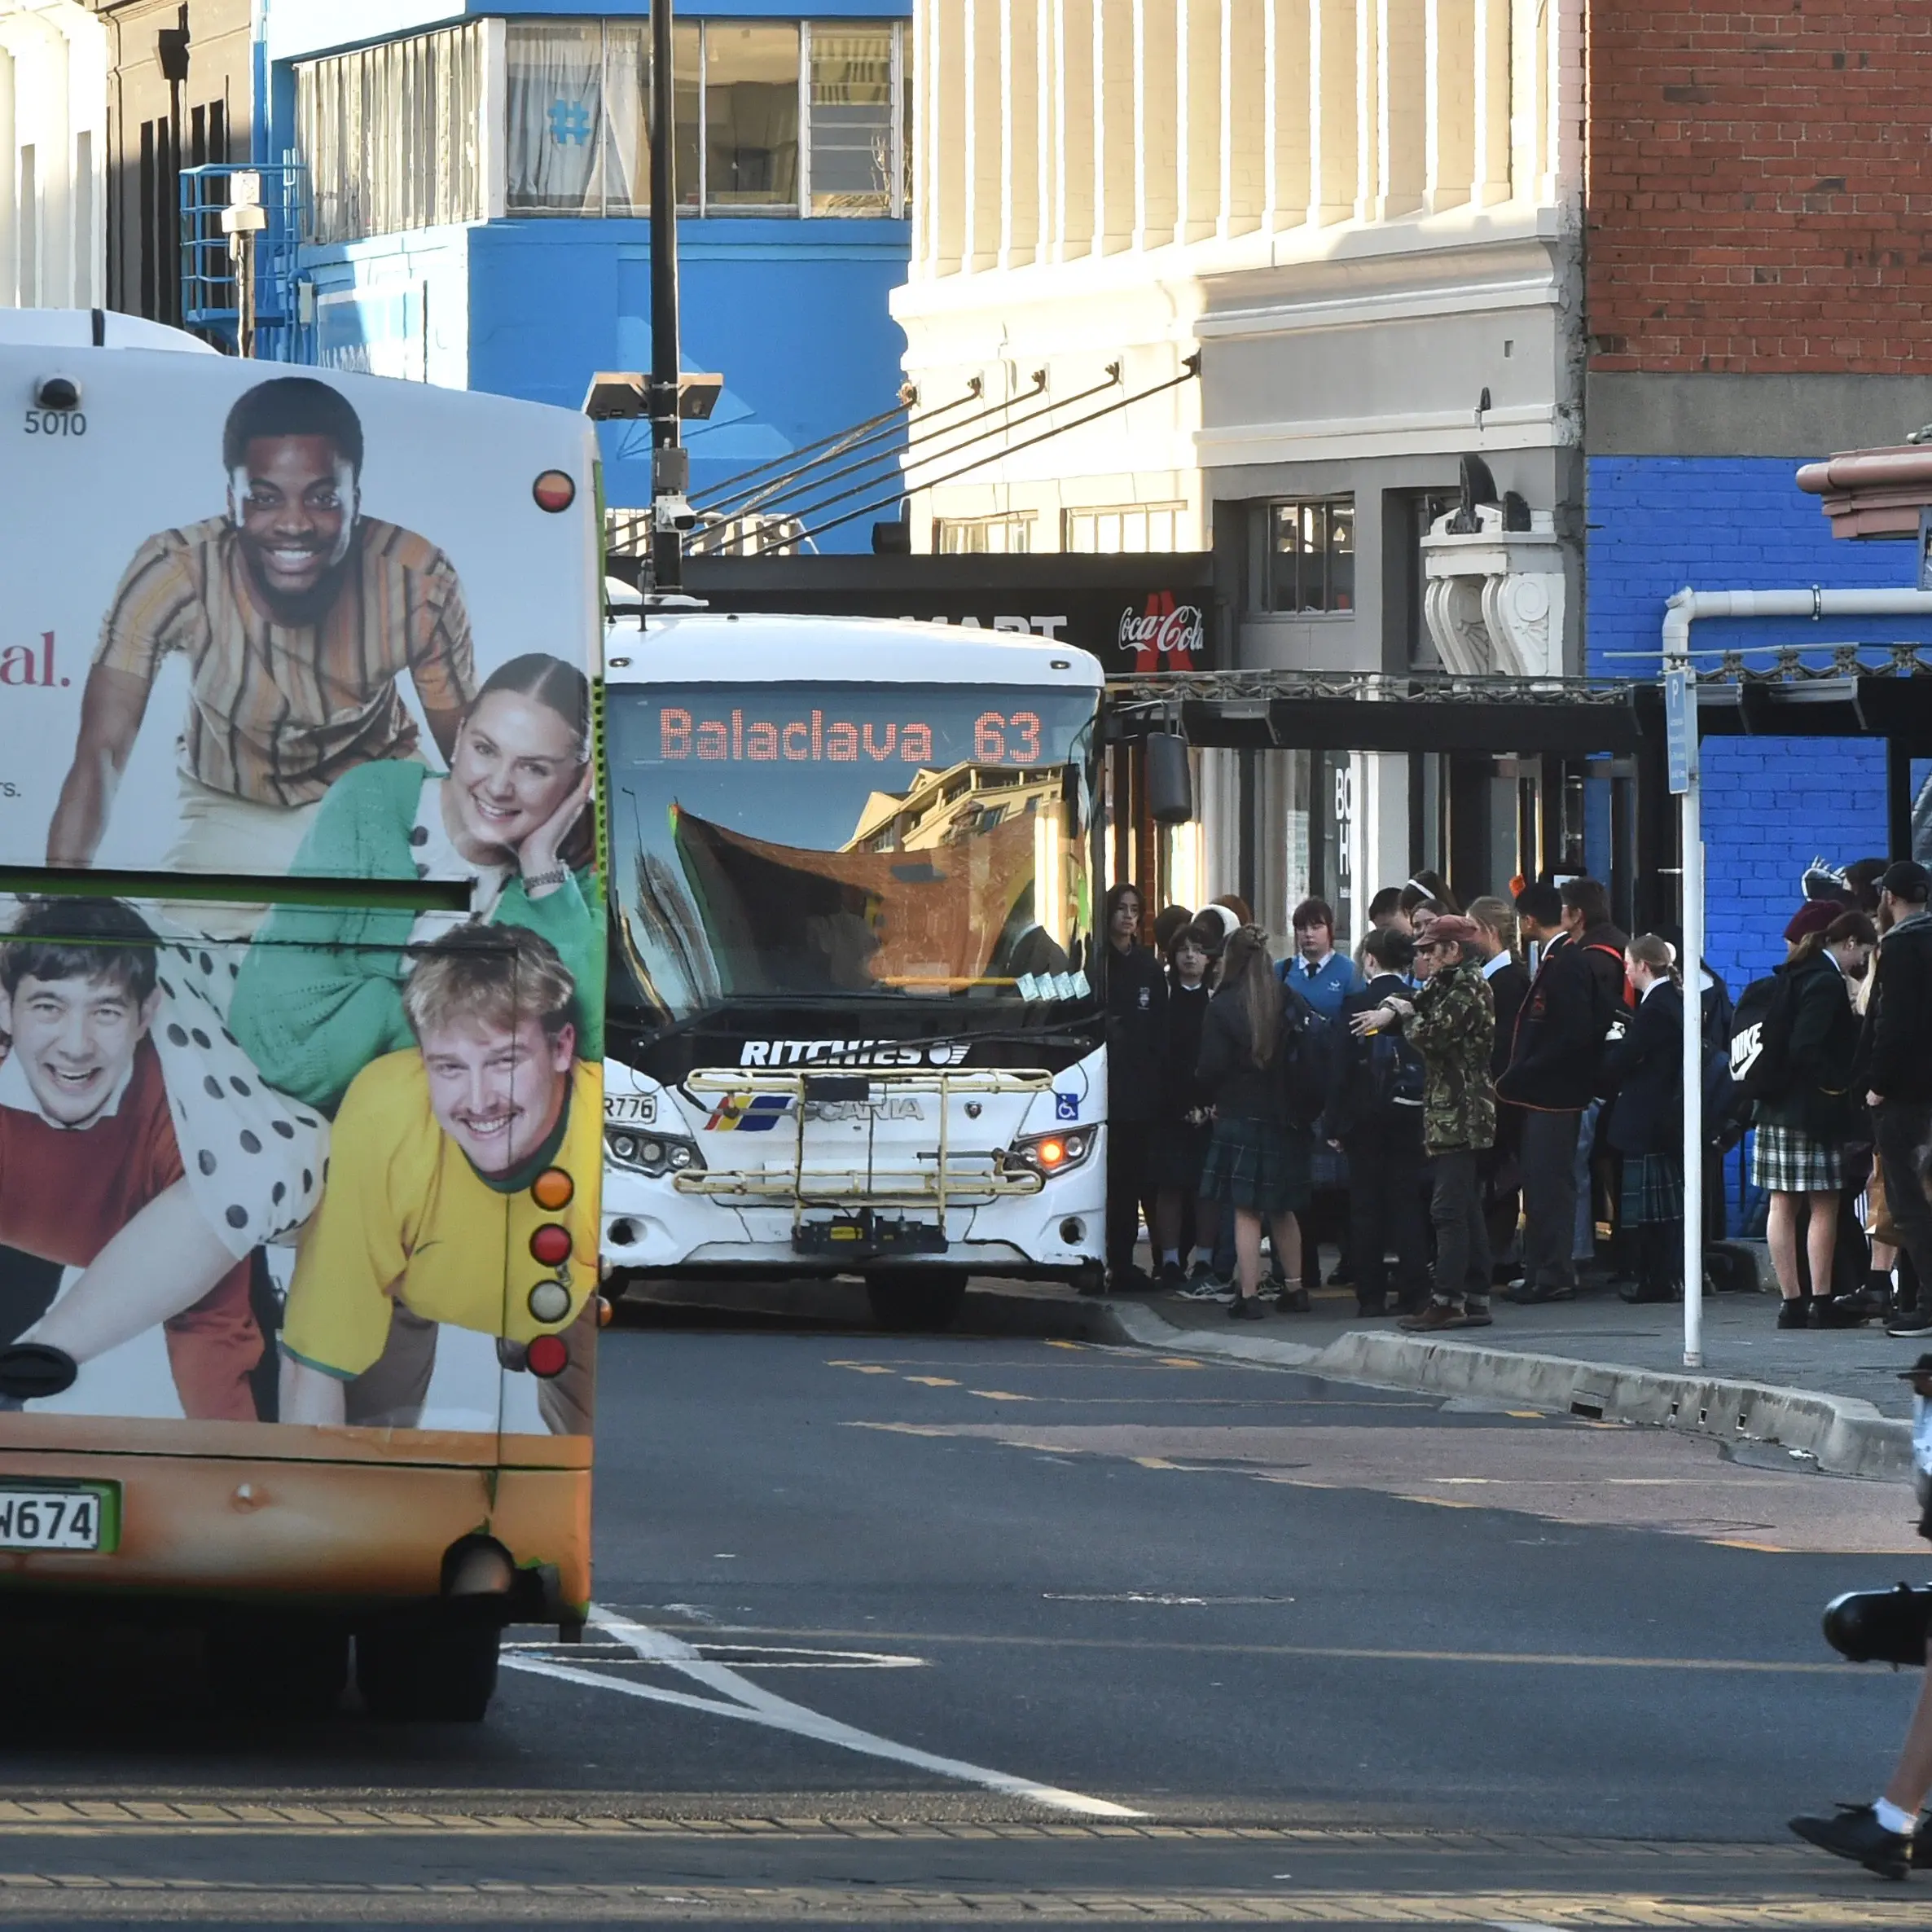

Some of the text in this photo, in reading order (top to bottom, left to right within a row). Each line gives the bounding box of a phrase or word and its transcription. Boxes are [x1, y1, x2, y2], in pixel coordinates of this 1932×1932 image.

[24, 411, 86, 436] 5010
[1118, 605, 1204, 652] Coca-Cola
[661, 708, 1040, 762] Balaclava 63
[740, 1040, 922, 1065] RITCHIES
[1732, 1021, 1763, 1067] NIKE
[604, 1098, 652, 1118] R776
